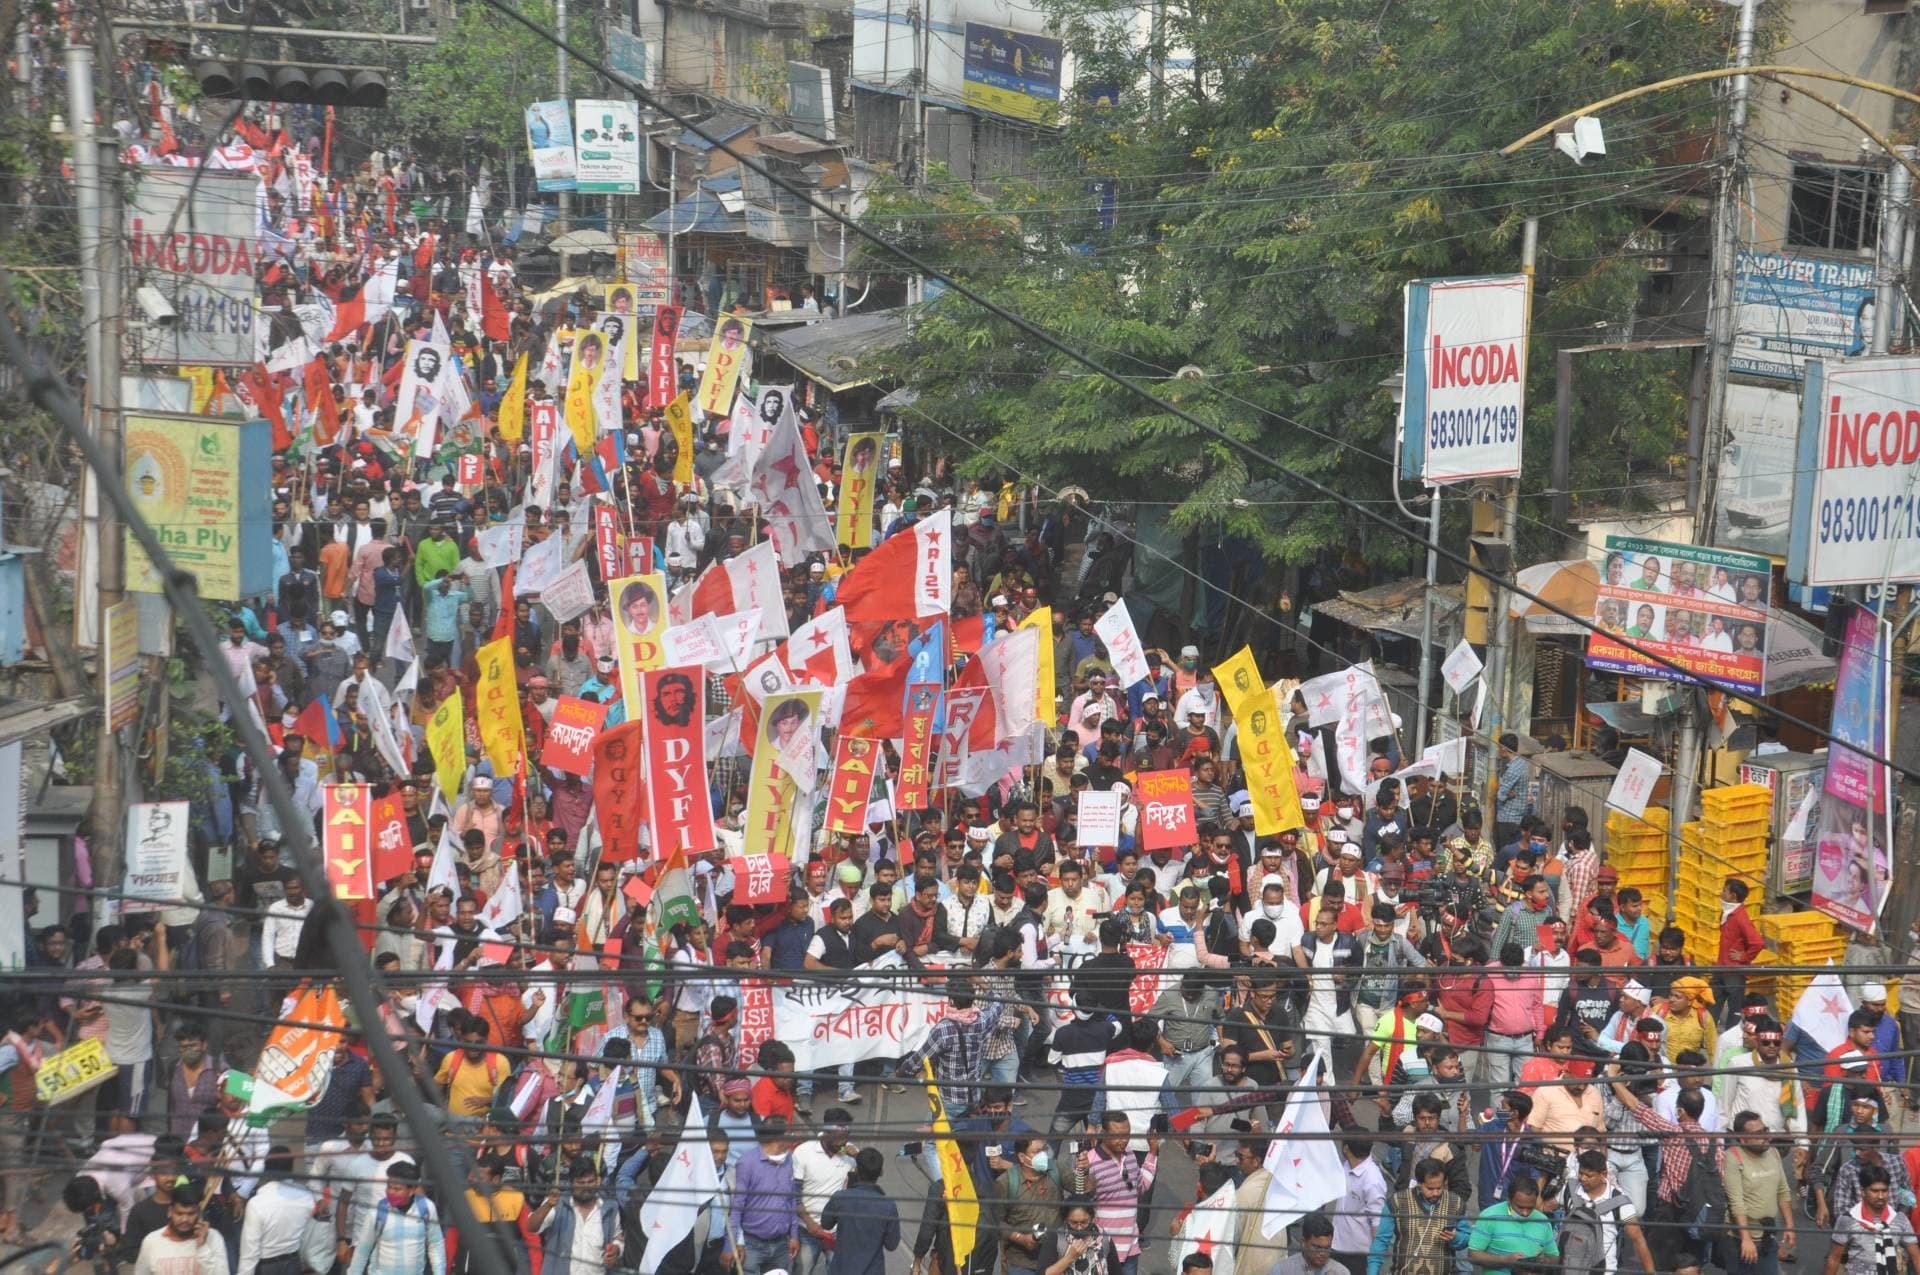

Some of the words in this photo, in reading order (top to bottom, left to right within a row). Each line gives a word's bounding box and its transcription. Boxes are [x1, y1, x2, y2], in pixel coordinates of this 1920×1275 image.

[656, 344, 672, 405] DYFI
[707, 353, 733, 411] DYFI
[1758, 361, 1793, 374] HOSTING
[1431, 405, 1517, 450] 9830012199
[196, 528, 232, 552] Ply
[599, 511, 617, 578] AISF
[662, 737, 694, 851] DYFI
[1750, 773, 1769, 785] GST
[1146, 801, 1188, 832] সিঙ্গুর
[327, 807, 367, 900] AIYL
